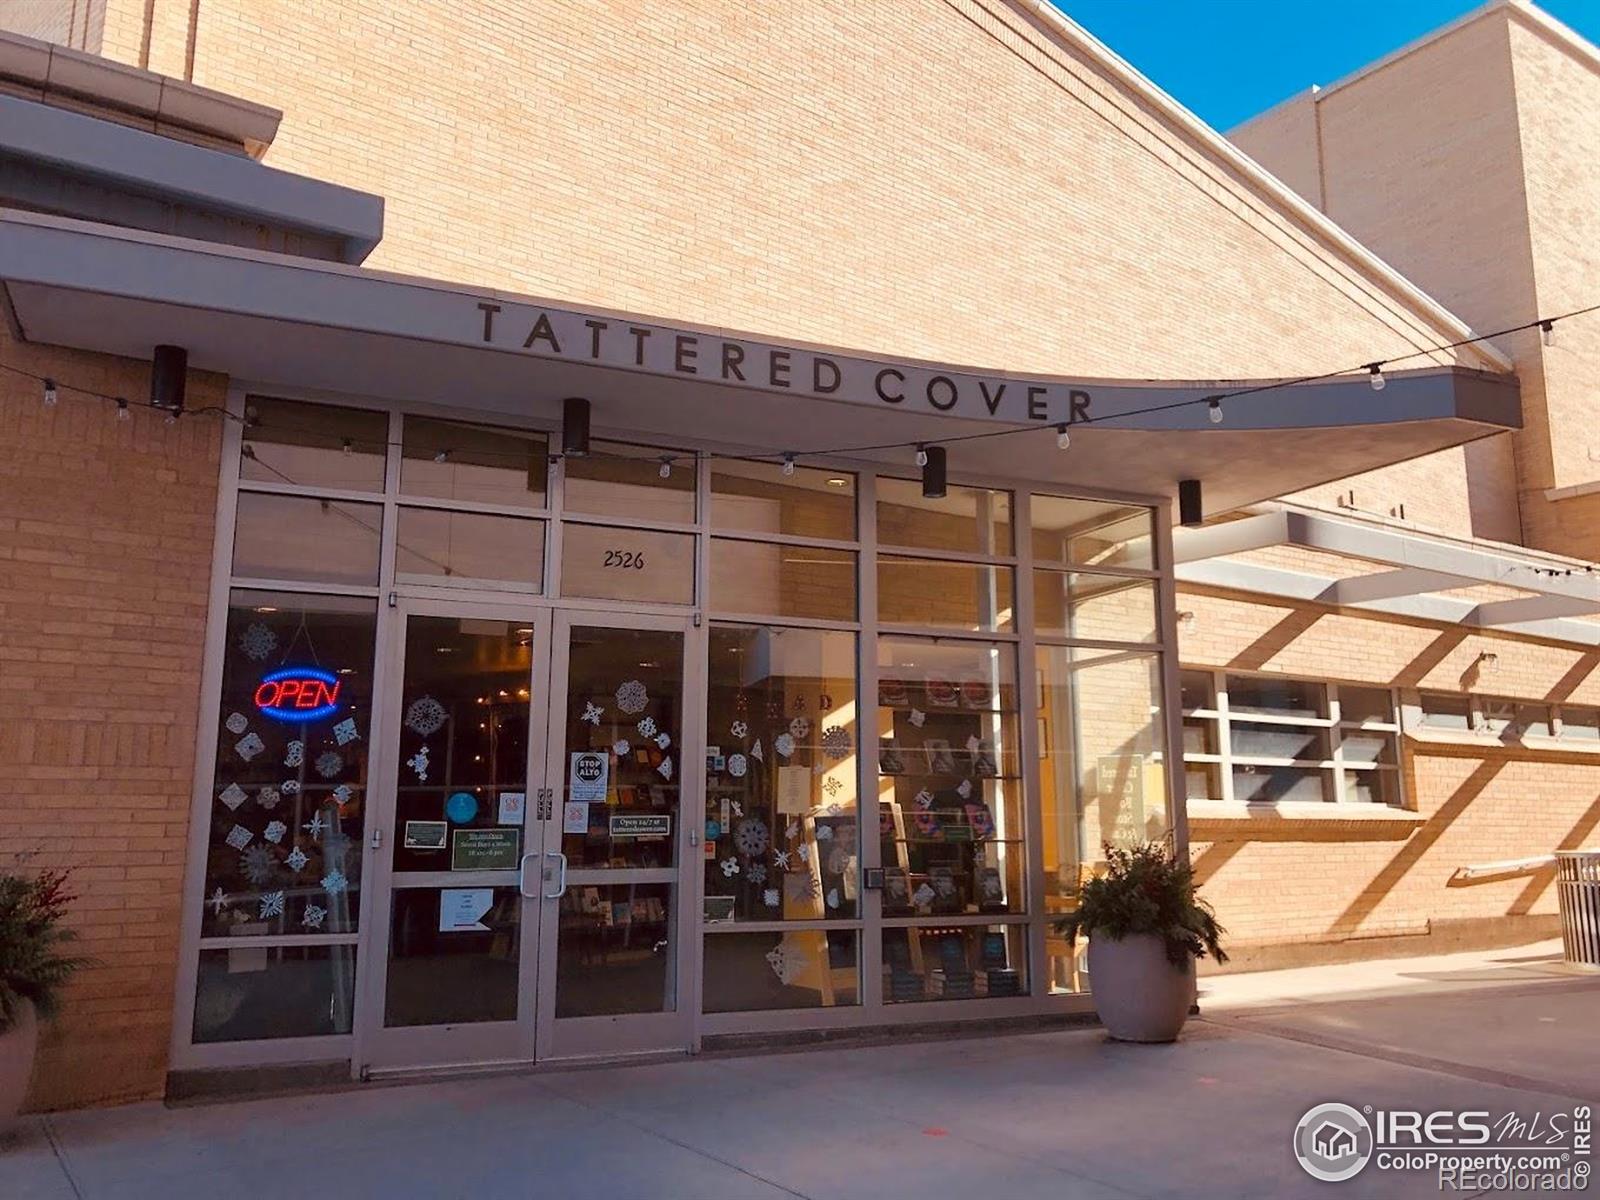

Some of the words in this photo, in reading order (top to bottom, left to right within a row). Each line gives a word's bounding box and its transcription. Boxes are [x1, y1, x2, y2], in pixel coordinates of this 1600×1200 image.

[478, 303, 842, 394] TATTERED
[875, 368, 1092, 422] COVER
[604, 550, 645, 570] 2526
[255, 681, 340, 708] OPEN
[579, 768, 600, 776] ALTO
[620, 818, 637, 827] Open
